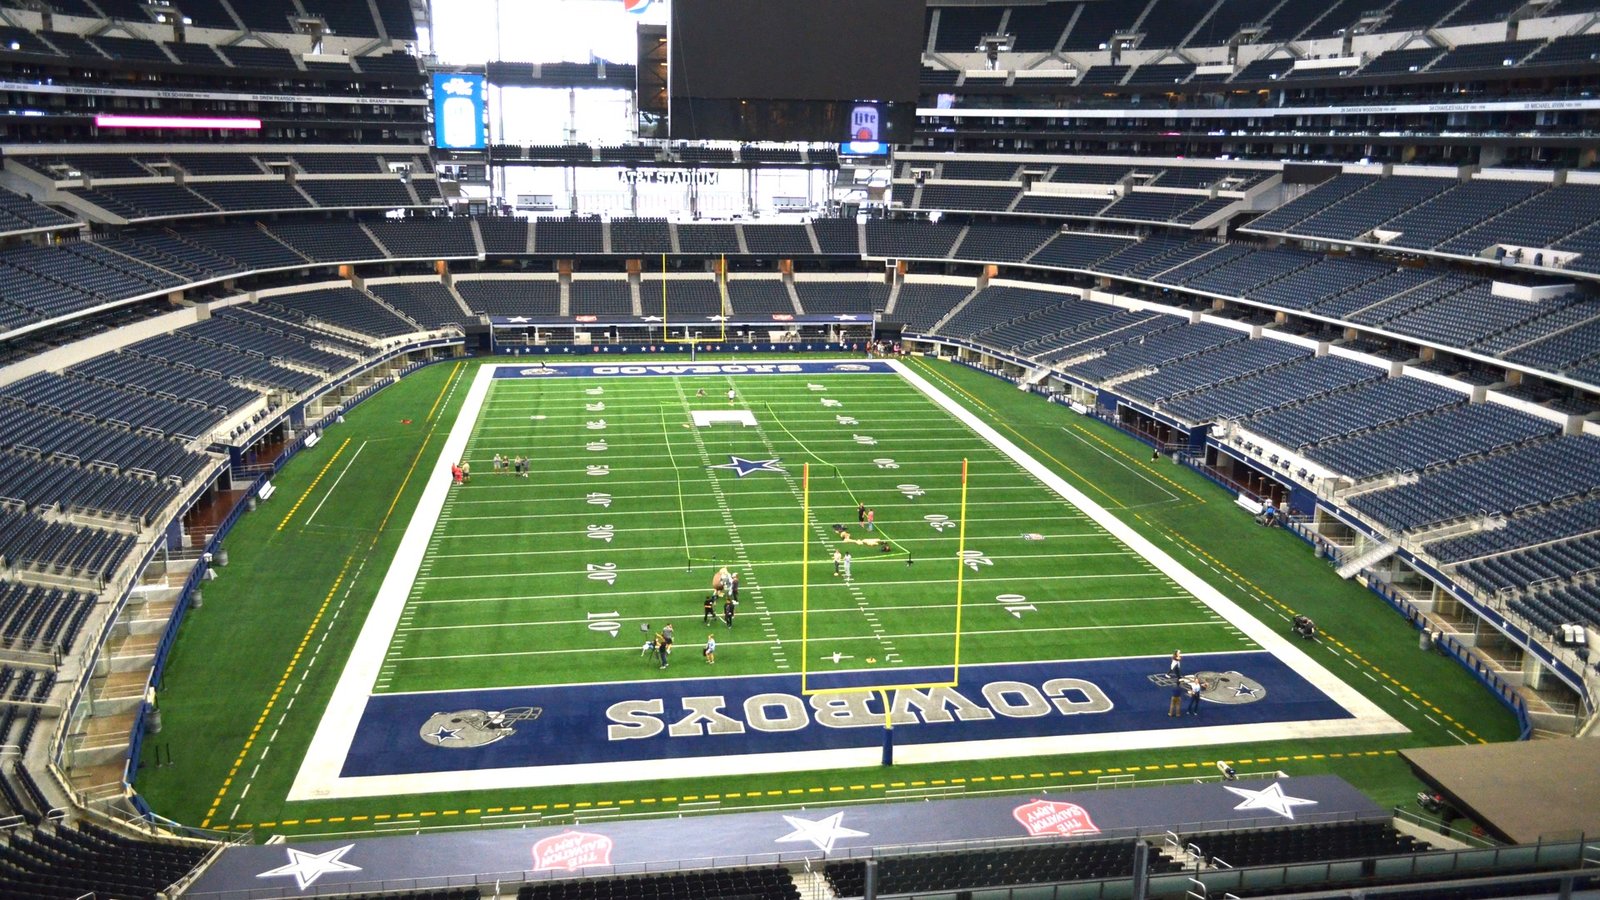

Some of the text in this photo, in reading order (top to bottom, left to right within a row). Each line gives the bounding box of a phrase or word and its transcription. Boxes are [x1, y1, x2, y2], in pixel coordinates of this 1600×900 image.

[855, 112, 876, 126] Lite
[619, 171, 719, 185] AT&T STADIUM
[586, 465, 610, 476] 50
[586, 492, 612, 504] 40
[923, 514, 956, 528] 30
[586, 524, 614, 538] 30
[956, 550, 994, 566] 20
[586, 562, 618, 580] 20
[995, 594, 1038, 612] 10
[587, 611, 621, 631] 10
[606, 678, 1114, 741] COWBOYS
[1026, 803, 1056, 822] ARMY
[1029, 806, 1082, 832] SALVATION
[1057, 818, 1082, 832] THE
[541, 839, 607, 868] SALVATION
[543, 835, 584, 857] ARMY
[567, 852, 598, 868] THE
